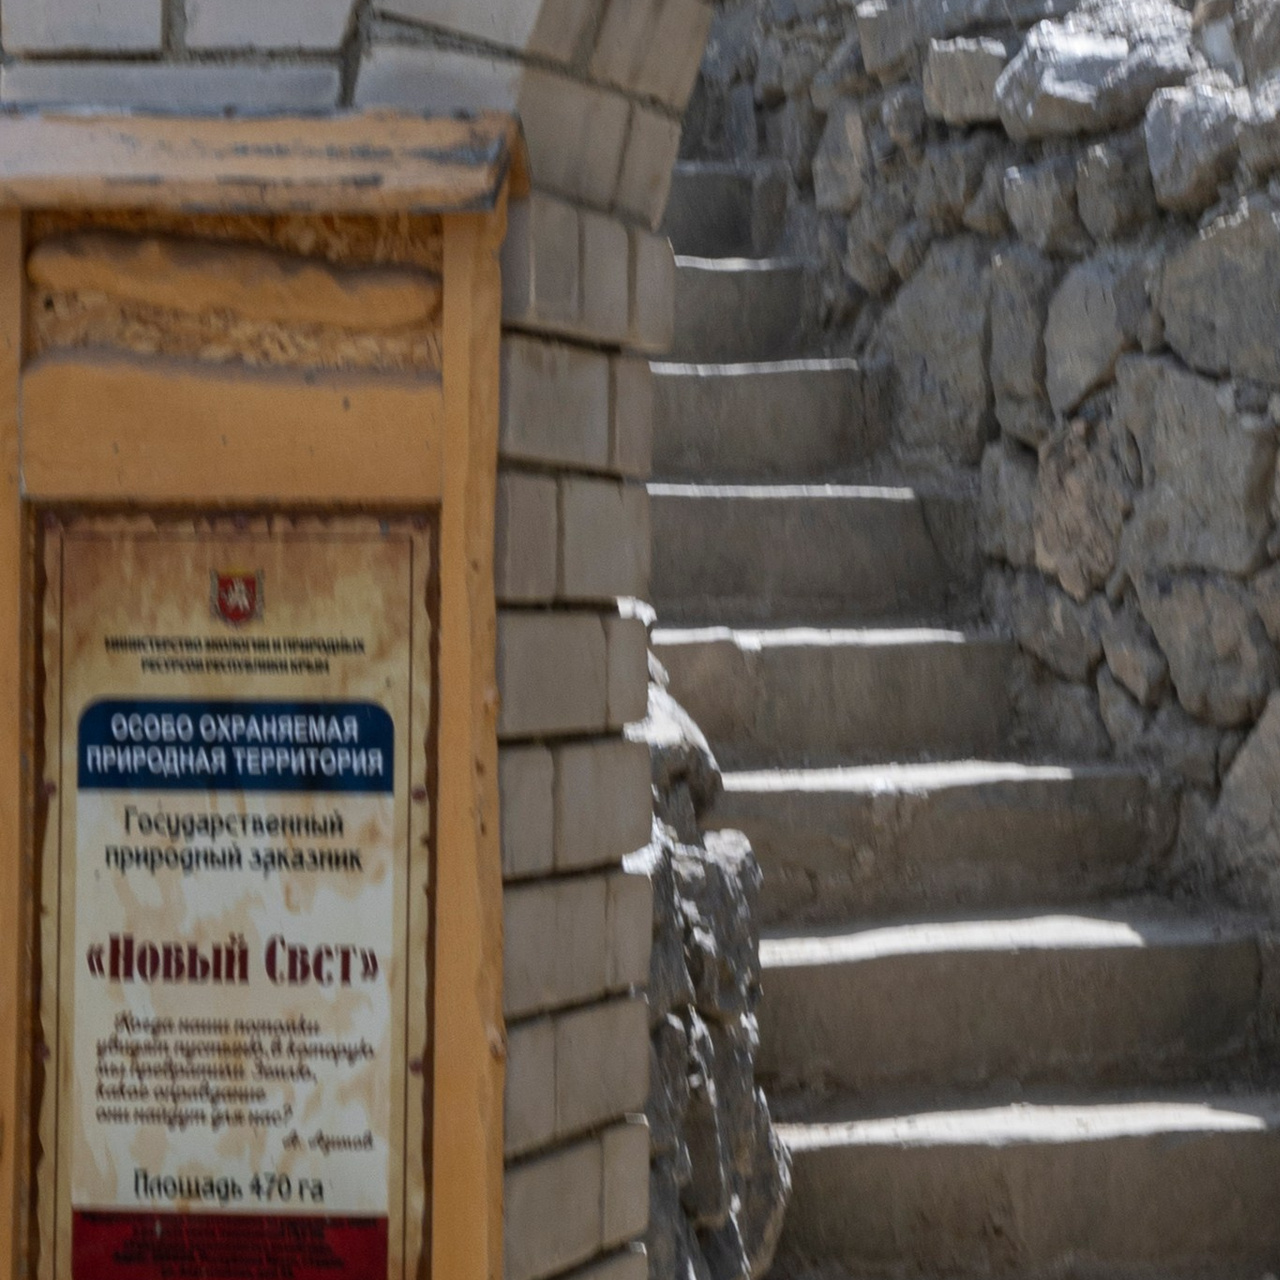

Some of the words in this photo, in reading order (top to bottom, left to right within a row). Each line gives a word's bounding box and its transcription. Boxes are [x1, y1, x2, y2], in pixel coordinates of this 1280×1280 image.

[111, 713, 194, 743] ОСОБО
[200, 714, 358, 744] ОХРАНЯЕМАЯ
[86, 745, 226, 777] ПРИРОДНАЯ
[233, 747, 383, 776] ТЕРРИТОРИЯ
[124, 804, 344, 838] Государственный
[105, 841, 243, 875] природный
[248, 846, 363, 873] заказник
[86, 933, 250, 986] «Новый
[265, 936, 379, 987] Свет»
[134, 1168, 242, 1207] Площадь
[250, 1172, 292, 1202] 470
[300, 1178, 324, 1202] га
